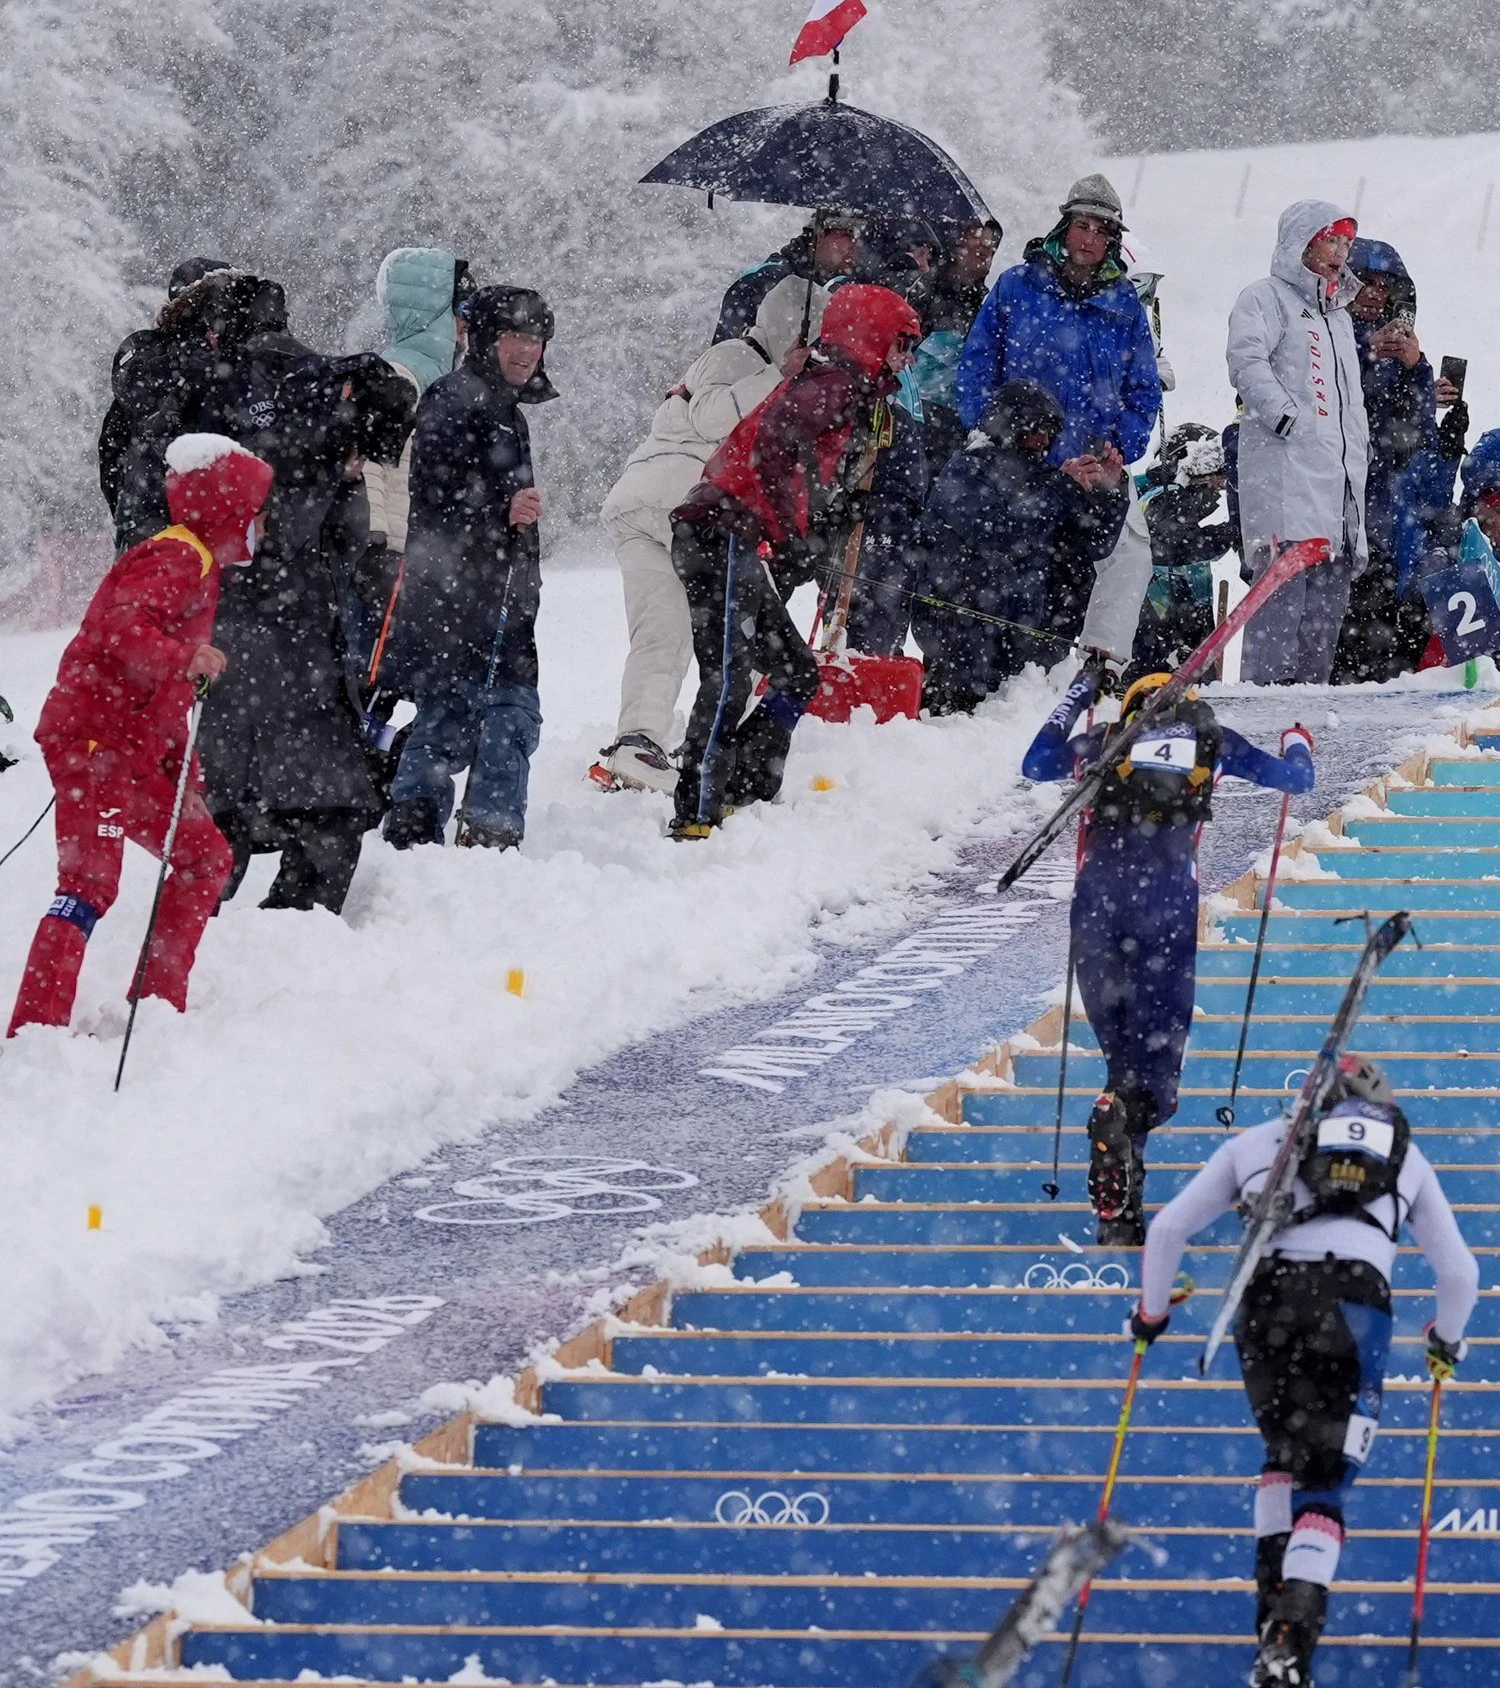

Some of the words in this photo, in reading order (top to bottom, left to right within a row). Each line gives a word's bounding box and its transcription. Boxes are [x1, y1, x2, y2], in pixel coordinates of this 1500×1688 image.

[1308, 330, 1328, 417] POLSKA
[249, 400, 275, 415] OBS
[1447, 591, 1486, 637] 2
[1154, 743, 1172, 762] 4
[97, 824, 125, 839] ESP
[1348, 1122, 1366, 1141] 9
[263, 1294, 447, 1354] 2026
